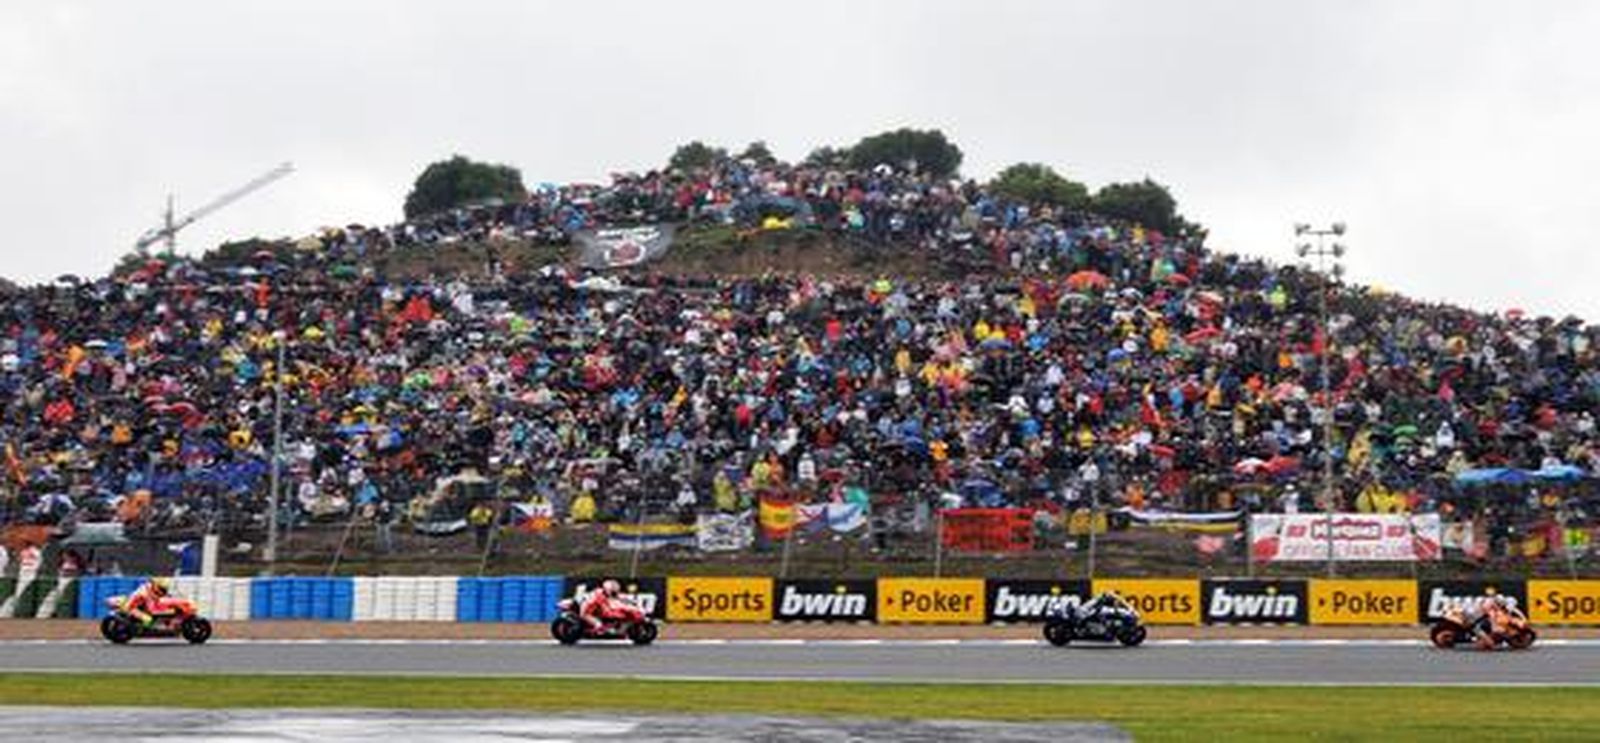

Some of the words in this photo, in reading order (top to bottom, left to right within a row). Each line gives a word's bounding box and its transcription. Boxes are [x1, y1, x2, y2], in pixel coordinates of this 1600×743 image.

[683, 588, 766, 615] Sports
[780, 586, 868, 616] bwin
[901, 588, 975, 613] Poker
[1112, 591, 1193, 614] orts
[1209, 586, 1299, 617] bwin
[1332, 590, 1408, 614] Poker
